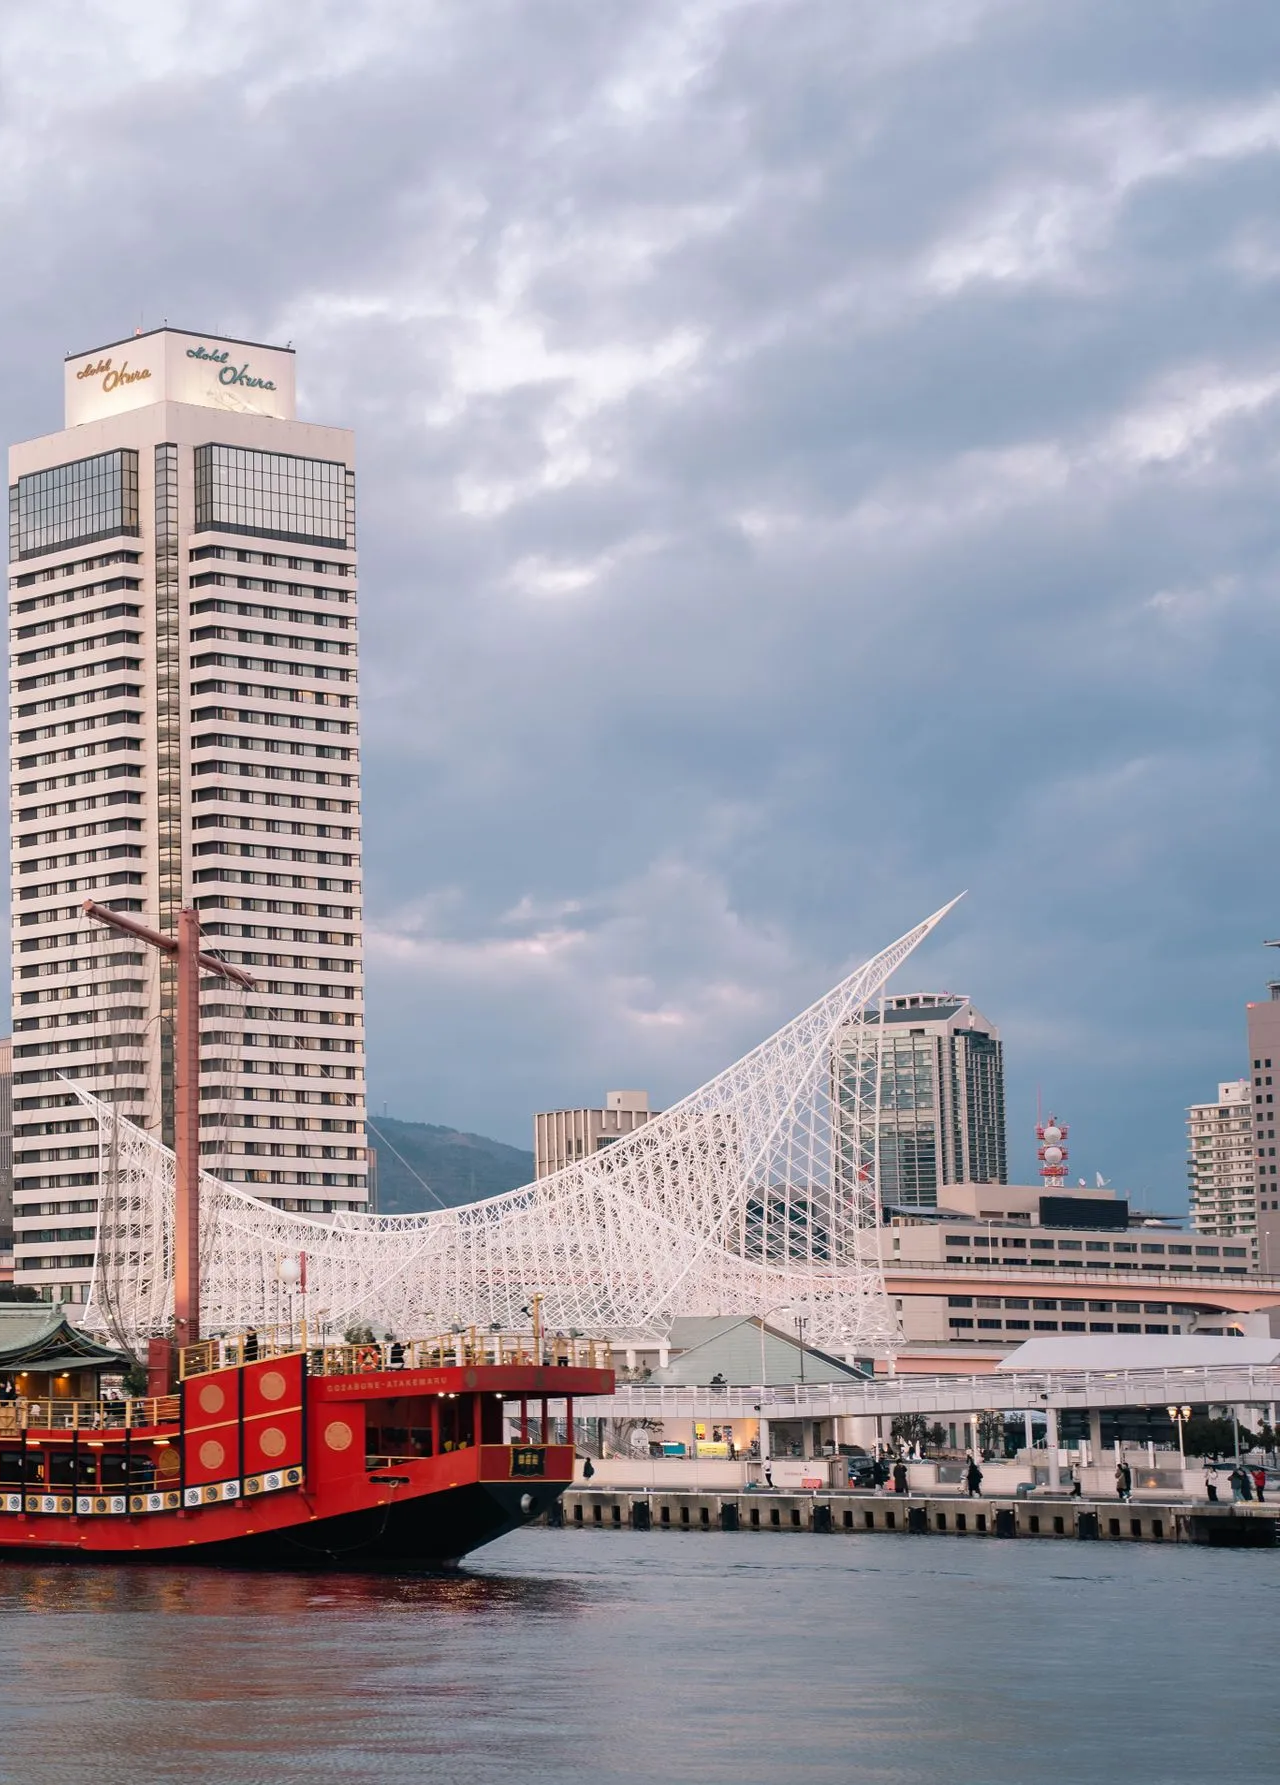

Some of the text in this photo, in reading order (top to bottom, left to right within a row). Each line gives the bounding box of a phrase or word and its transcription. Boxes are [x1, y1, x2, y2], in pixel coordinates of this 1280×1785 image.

[186, 346, 229, 364] Hotel
[77, 358, 111, 379] Hotel
[102, 360, 151, 393] Okura
[219, 364, 277, 391] Okura
